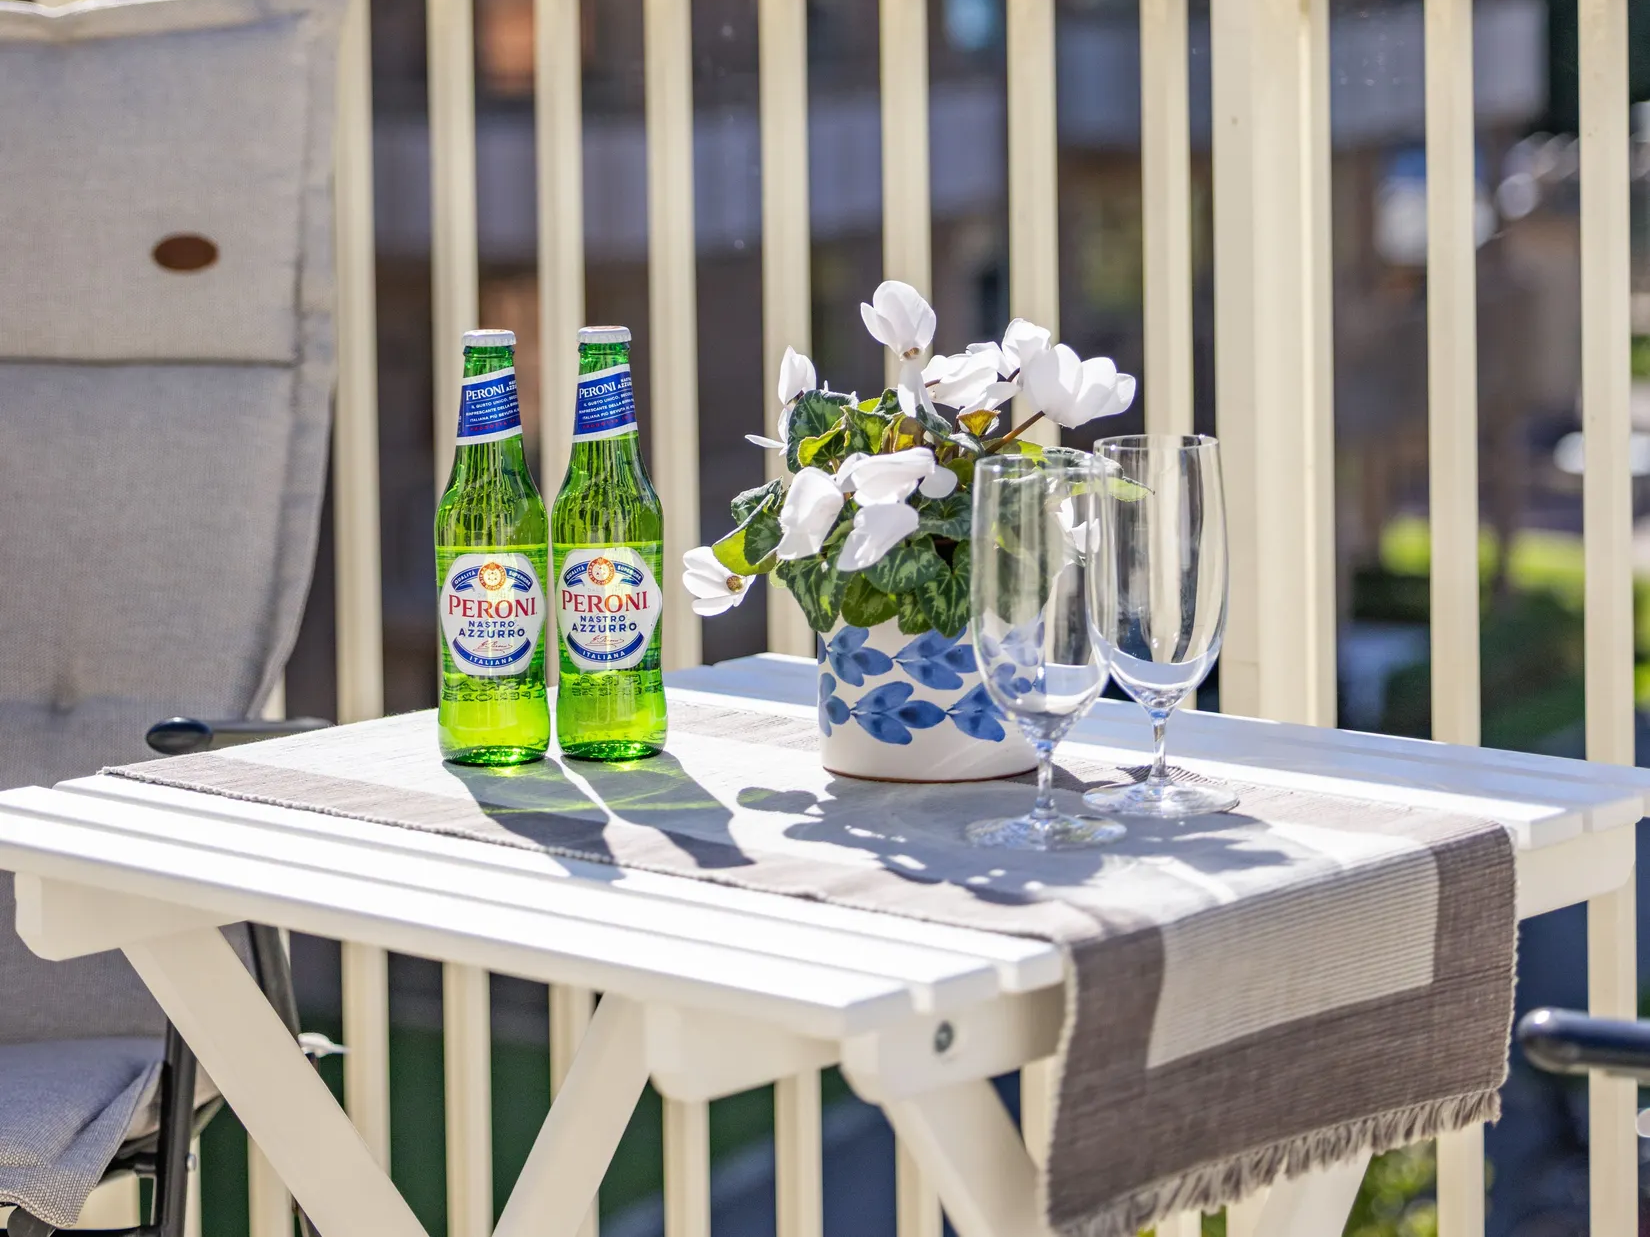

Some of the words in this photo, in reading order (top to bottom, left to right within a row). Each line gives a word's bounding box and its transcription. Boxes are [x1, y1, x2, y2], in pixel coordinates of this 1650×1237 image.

[466, 384, 506, 401] PERONI
[579, 382, 616, 399] PERONI
[448, 594, 536, 619] PERONI
[562, 589, 648, 614] PERONI
[468, 620, 515, 628] NASTRO
[580, 615, 626, 623] NASTRO
[572, 623, 637, 633] AZZURRO
[458, 628, 525, 639] AZZURRO
[582, 650, 626, 660] ITALIANA
[469, 656, 513, 666] ITALIANA
